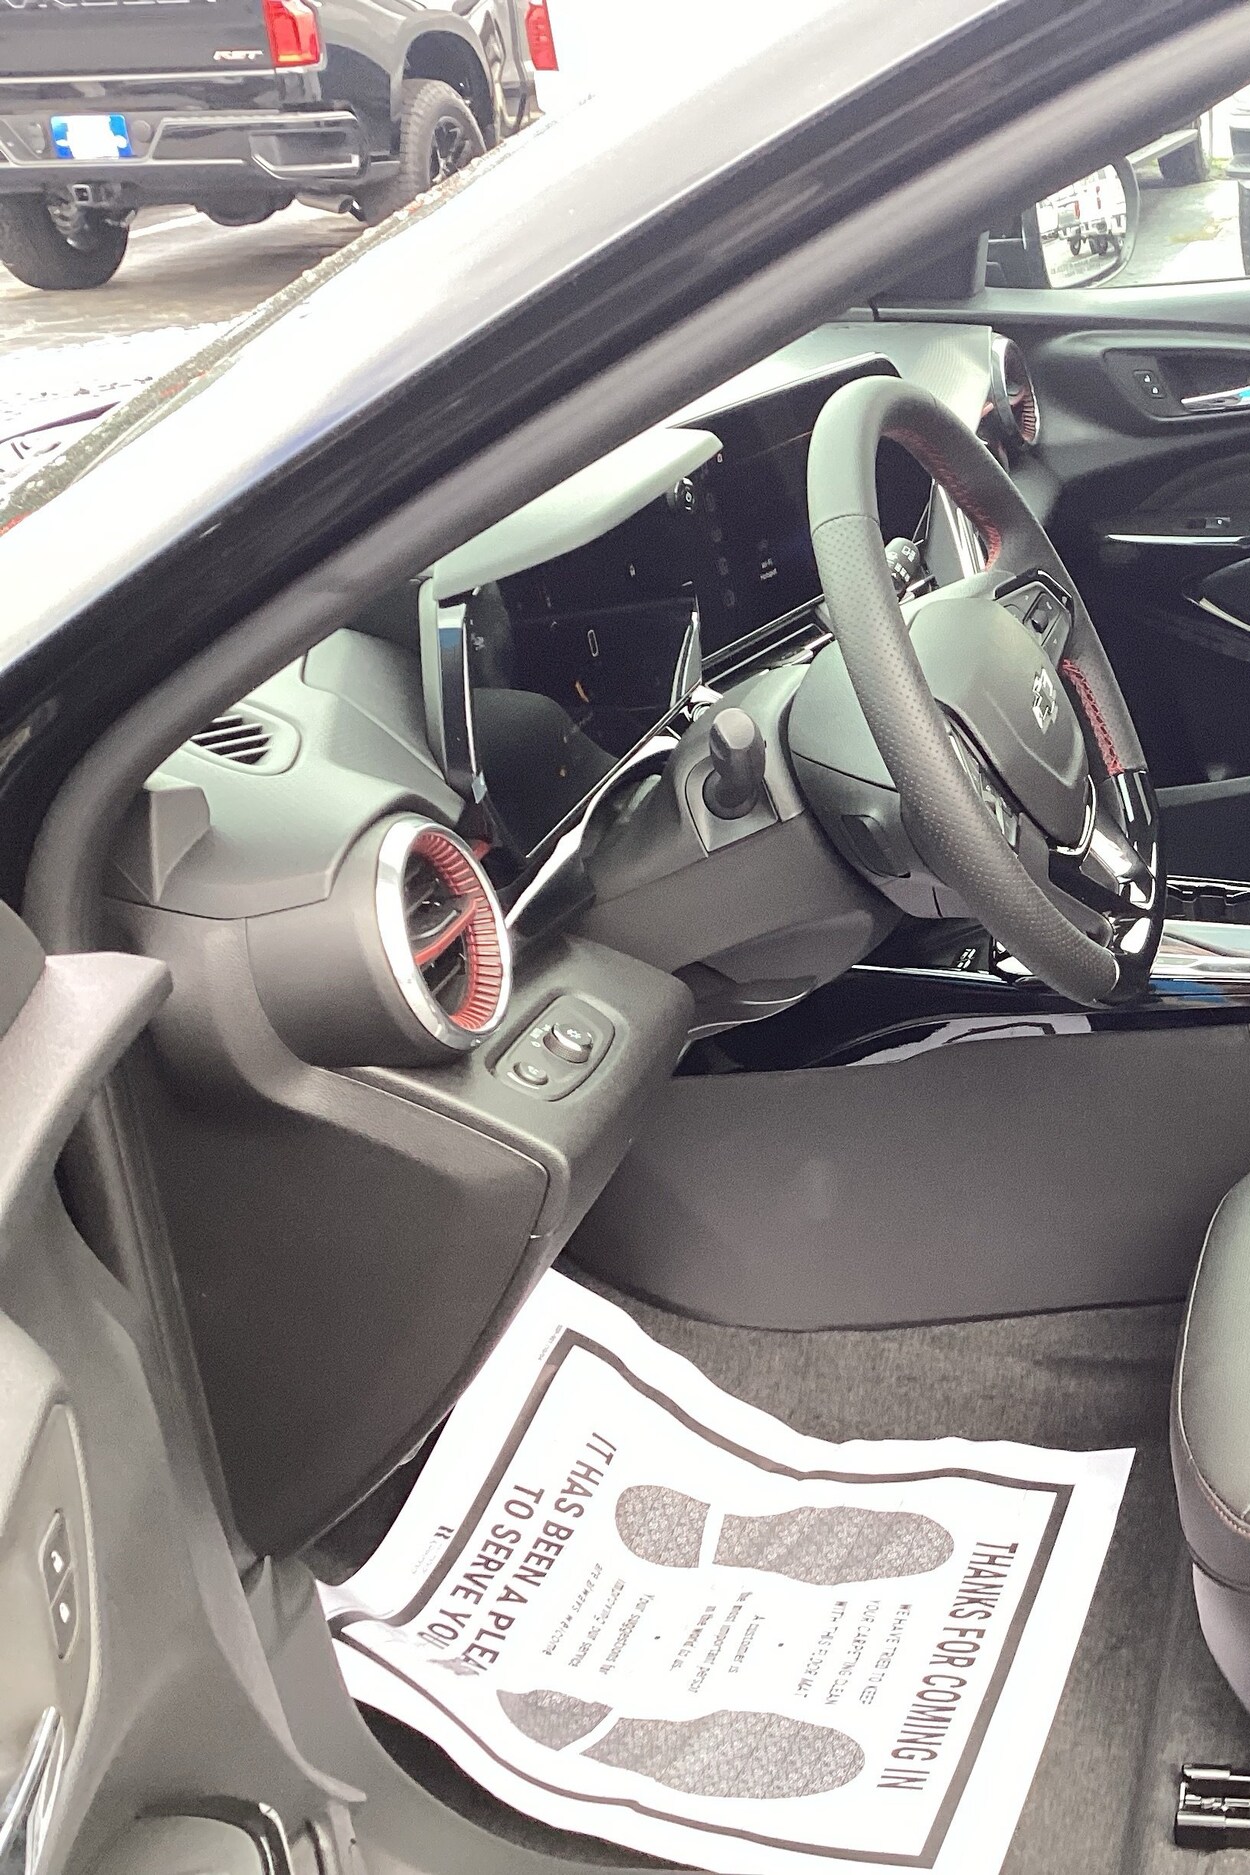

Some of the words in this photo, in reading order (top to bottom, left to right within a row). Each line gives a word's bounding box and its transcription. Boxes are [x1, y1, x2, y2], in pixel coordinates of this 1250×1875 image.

[586, 1432, 617, 1466] IT
[504, 1484, 545, 1520] TO
[555, 1460, 604, 1518] HAS
[450, 1524, 521, 1605] SERVE
[512, 1520, 575, 1587] BEEN
[496, 1584, 529, 1604] A
[948, 1542, 1019, 1620] THANKS
[929, 1627, 986, 1668] FOR
[891, 1674, 968, 1761] COMING
[876, 1768, 930, 1790] IN
